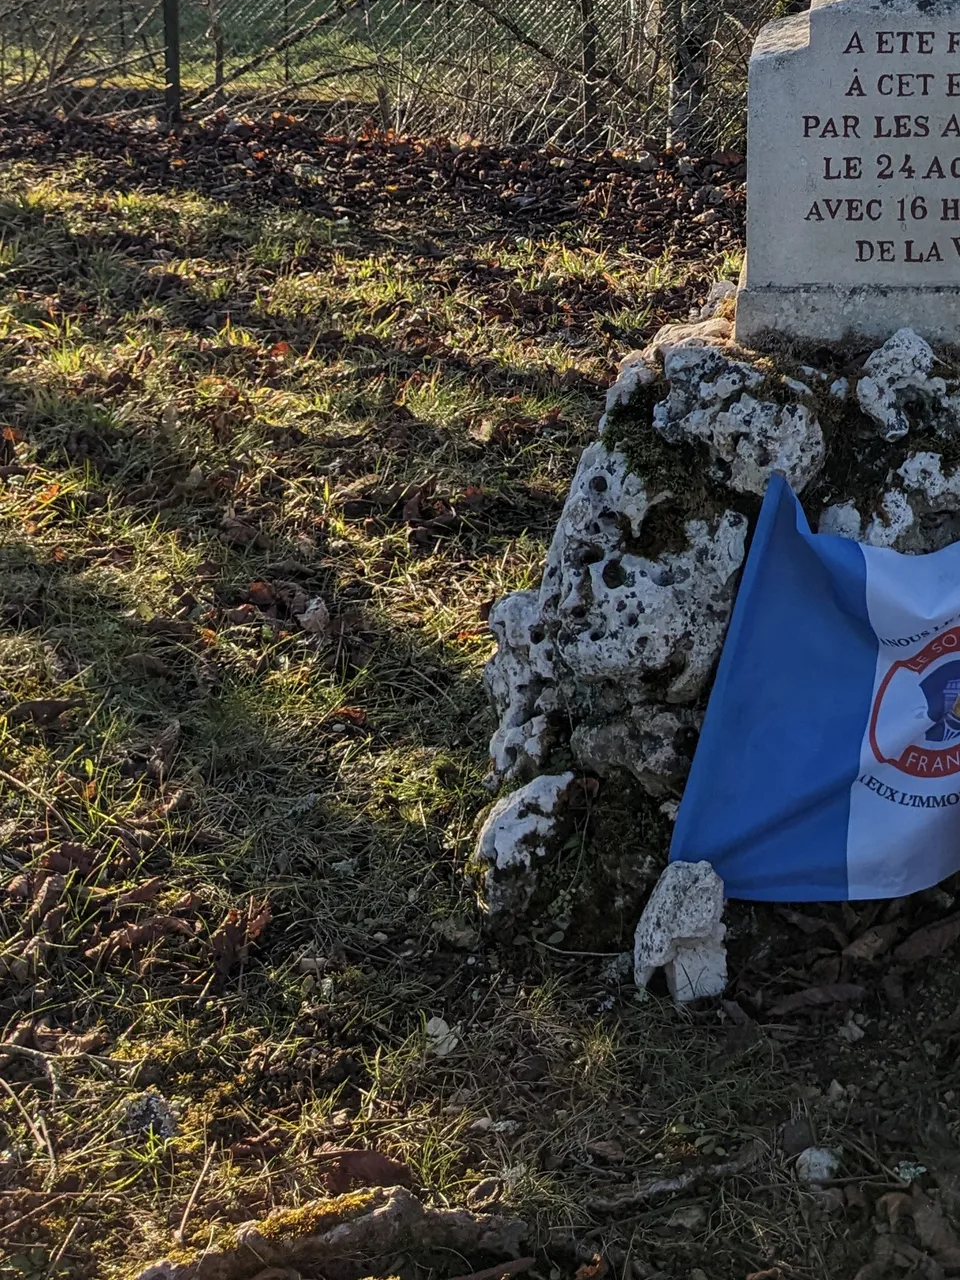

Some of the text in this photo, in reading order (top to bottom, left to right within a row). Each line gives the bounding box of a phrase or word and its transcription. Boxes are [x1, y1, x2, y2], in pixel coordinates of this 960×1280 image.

[842, 31, 866, 54] A
[875, 31, 936, 55] ETE
[877, 73, 935, 97] CET
[802, 115, 861, 138] PAR
[873, 114, 930, 138] LES
[822, 156, 863, 180] LE
[875, 153, 917, 180] 24
[804, 198, 883, 221] AVEC
[897, 196, 928, 221] 16
[855, 239, 895, 263] DE
[904, 239, 944, 263] LA
[889, 630, 930, 648] NOUS
[907, 655, 929, 670] LE
[864, 775, 900, 803] EUX
